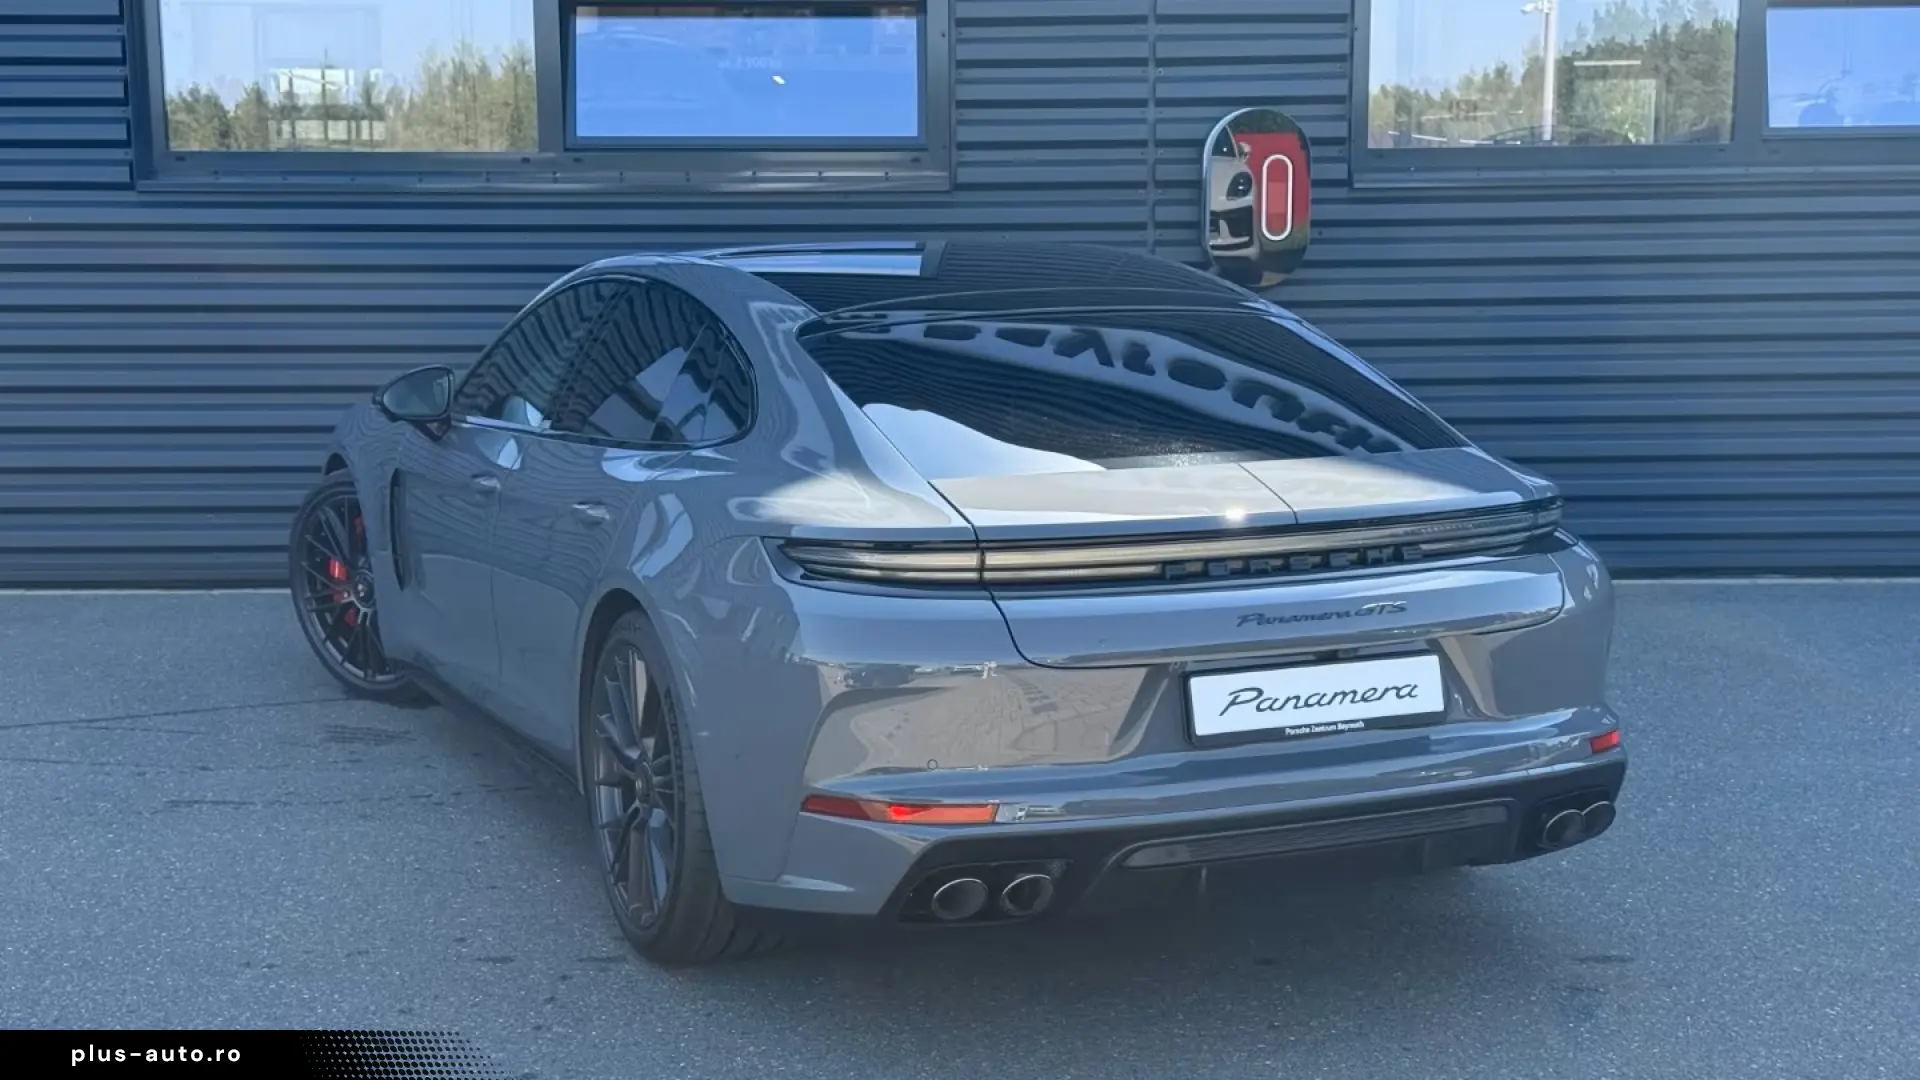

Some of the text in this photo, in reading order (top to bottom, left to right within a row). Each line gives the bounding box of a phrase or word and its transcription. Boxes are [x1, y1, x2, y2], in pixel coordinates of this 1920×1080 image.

[1236, 600, 1408, 628] Panamera GTS
[1218, 683, 1419, 717] Panamera
[1285, 727, 1310, 736] Porsche
[1311, 724, 1337, 733] Zentrum
